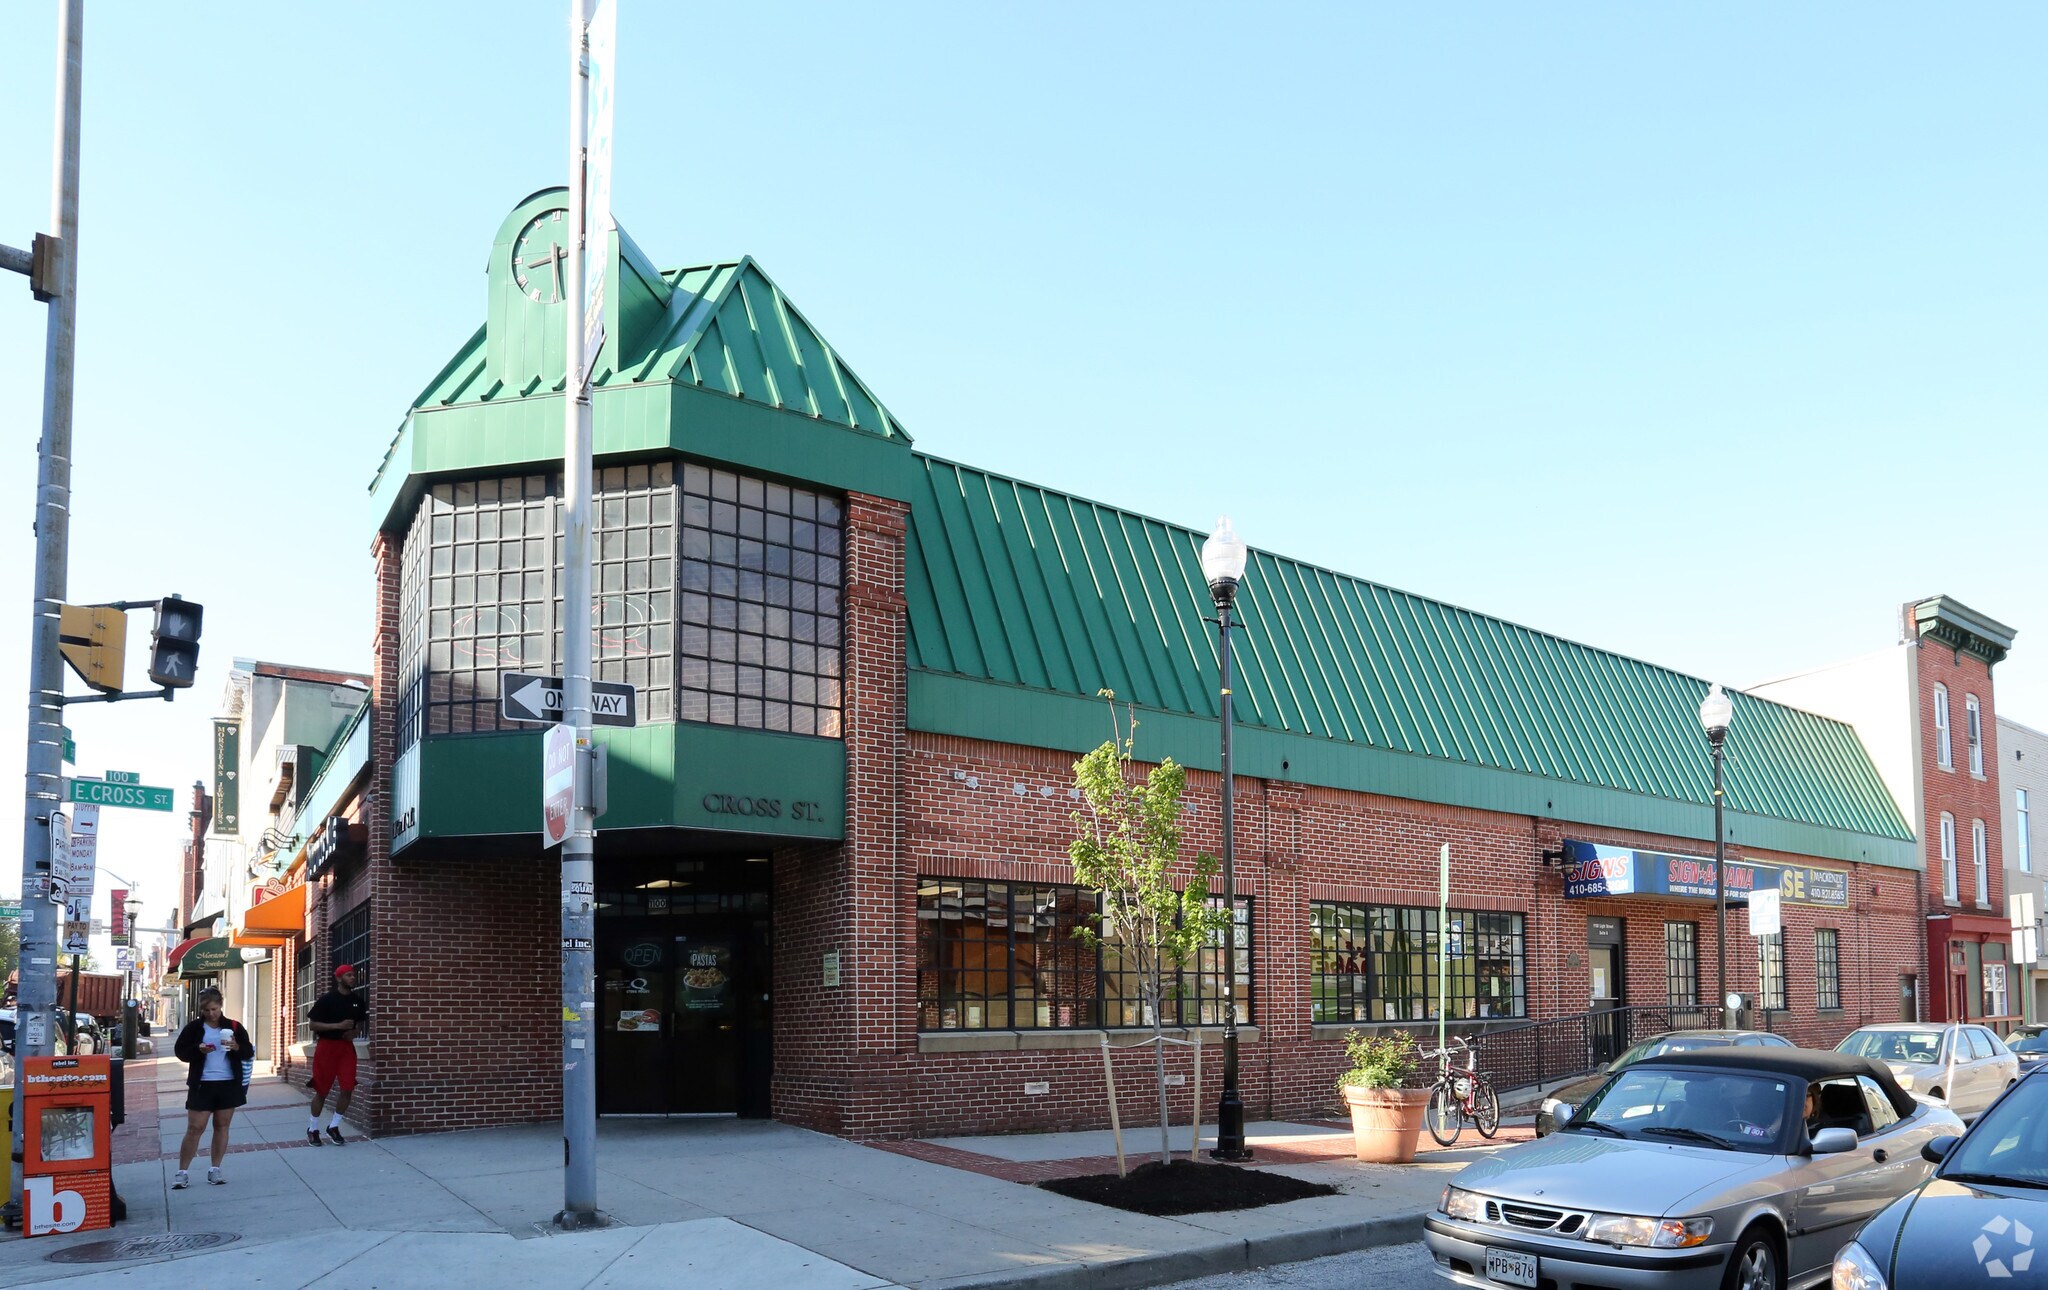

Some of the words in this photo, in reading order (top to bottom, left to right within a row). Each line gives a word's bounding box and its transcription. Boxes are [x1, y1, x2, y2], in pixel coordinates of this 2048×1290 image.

[545, 691, 563, 708] ON
[549, 752, 556, 770] DO
[559, 743, 570, 762] NOT
[109, 771, 128, 782] 100
[154, 794, 168, 804] ST.
[703, 794, 781, 818] CROSS
[792, 801, 824, 822] ST.
[72, 849, 93, 857] MONDAY
[1568, 856, 1628, 882] SIGNS
[1669, 885, 1688, 894] WHERE
[1689, 886, 1699, 894] THE
[1699, 888, 1717, 896] WORLD
[648, 899, 667, 909] 100
[3, 907, 20, 916] Wes
[67, 922, 78, 930] PAY
[575, 939, 591, 948] inc.
[624, 948, 662, 962] OPEN
[692, 953, 717, 967] PASTAS
[27, 1074, 107, 1083] bthesite.com
[34, 1221, 76, 1230] bthesite.com
